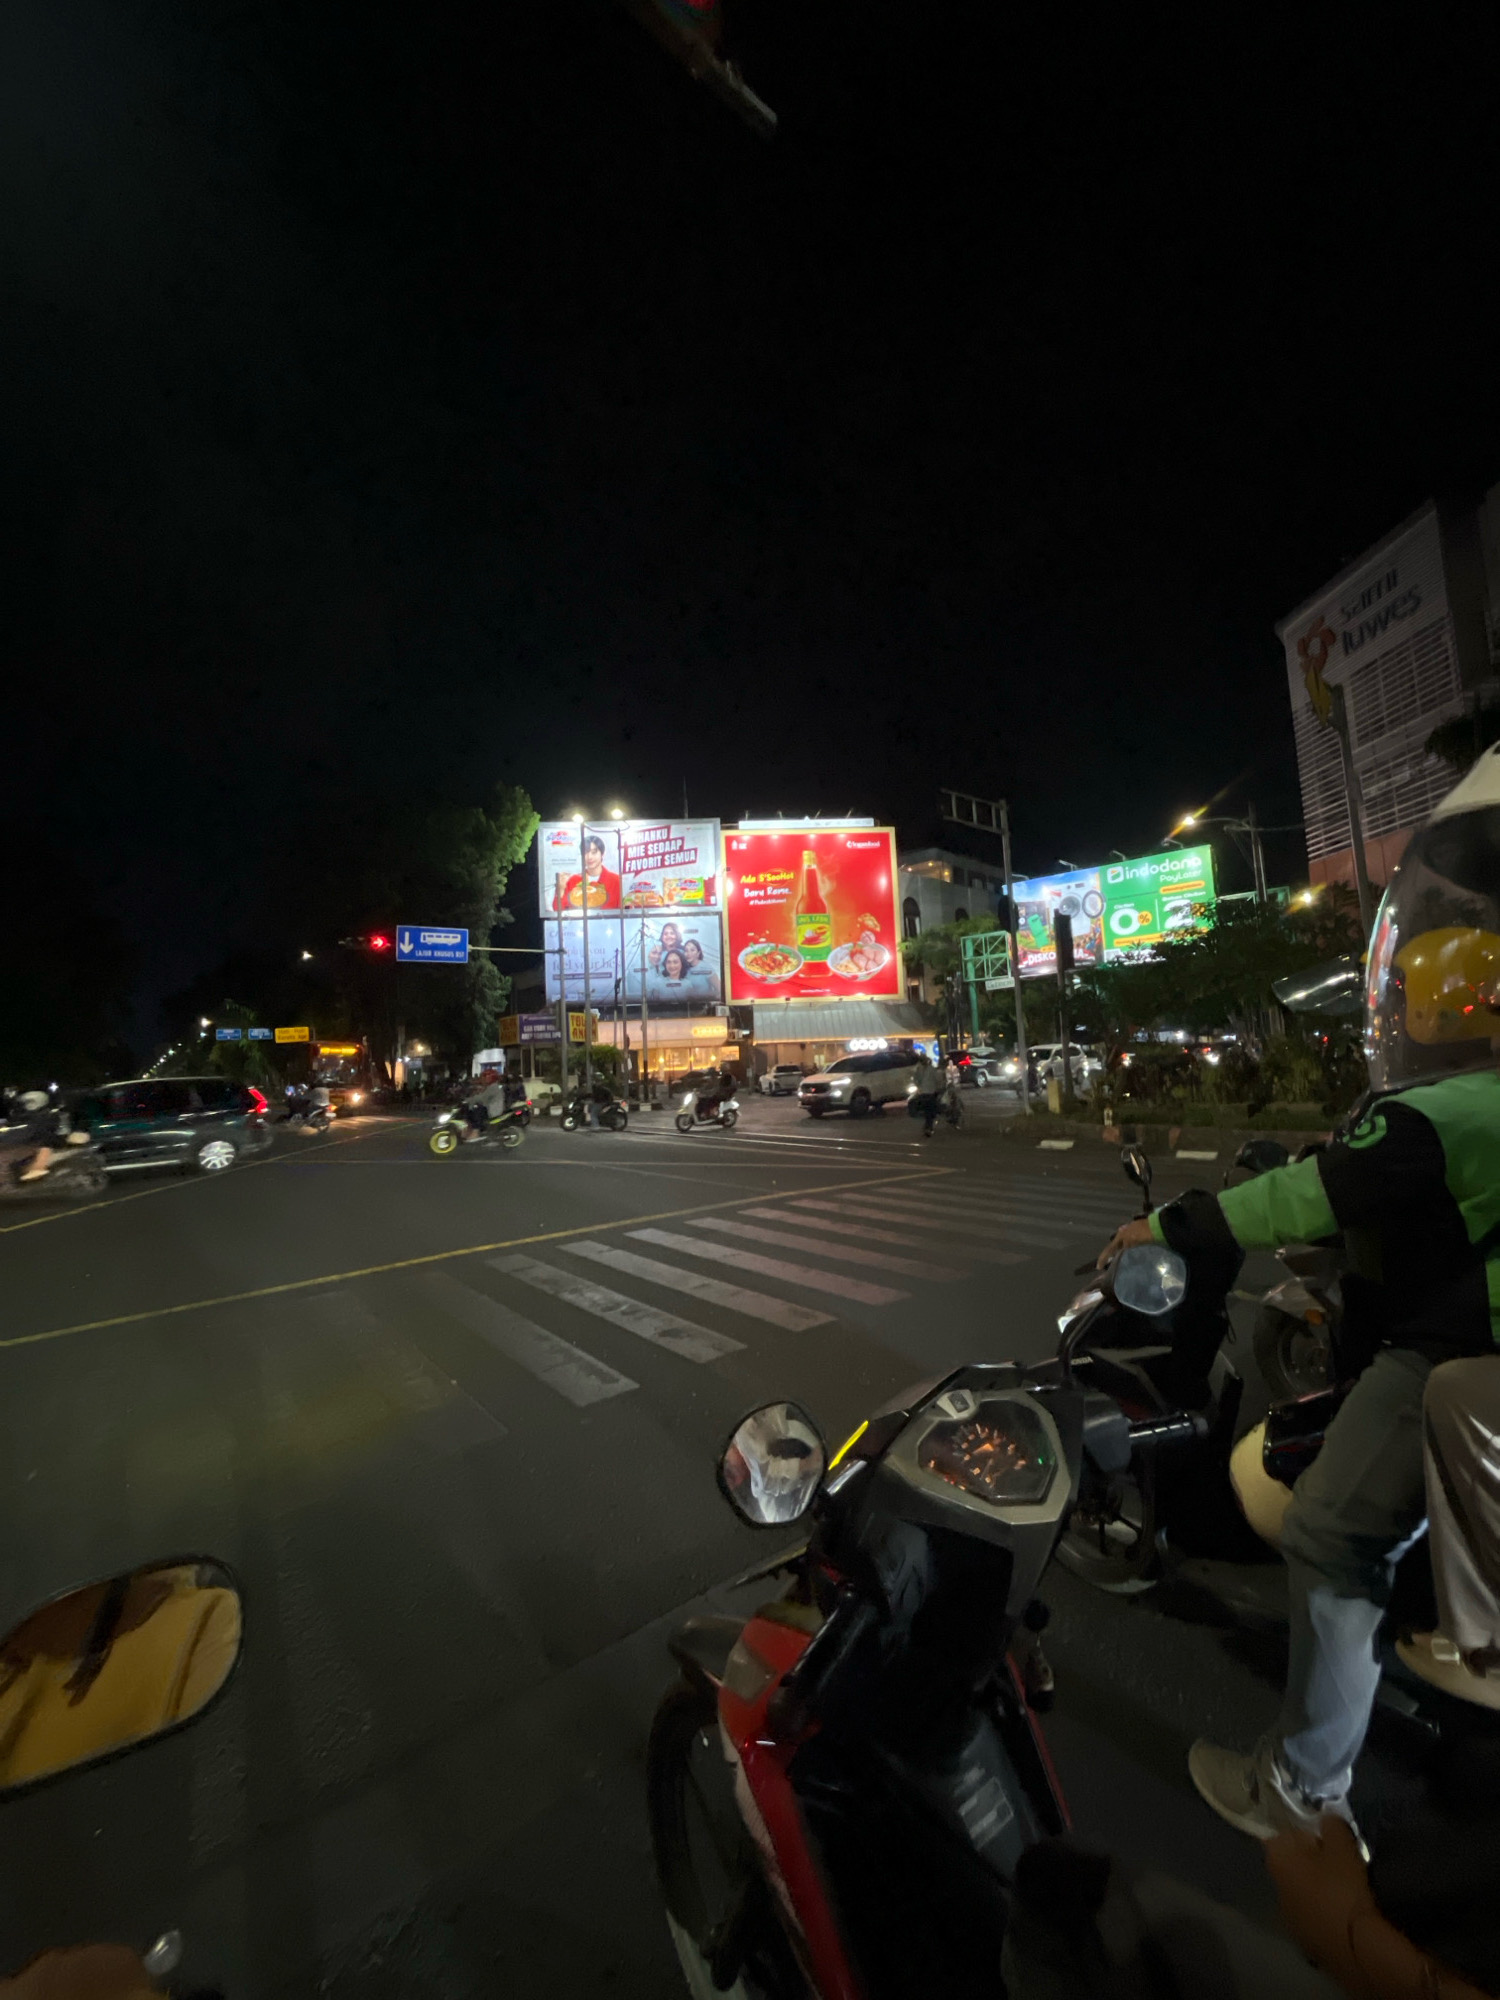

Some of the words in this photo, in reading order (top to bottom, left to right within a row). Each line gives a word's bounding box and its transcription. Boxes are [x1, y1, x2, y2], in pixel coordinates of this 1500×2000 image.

[628, 845, 645, 858] MIE
[647, 839, 682, 855] SEDAAP
[626, 855, 662, 872] FAVORIT
[664, 850, 696, 865] SEMUA
[1125, 857, 1202, 879] indodana
[1160, 870, 1202, 883] PayLater
[744, 888, 765, 898] Baru
